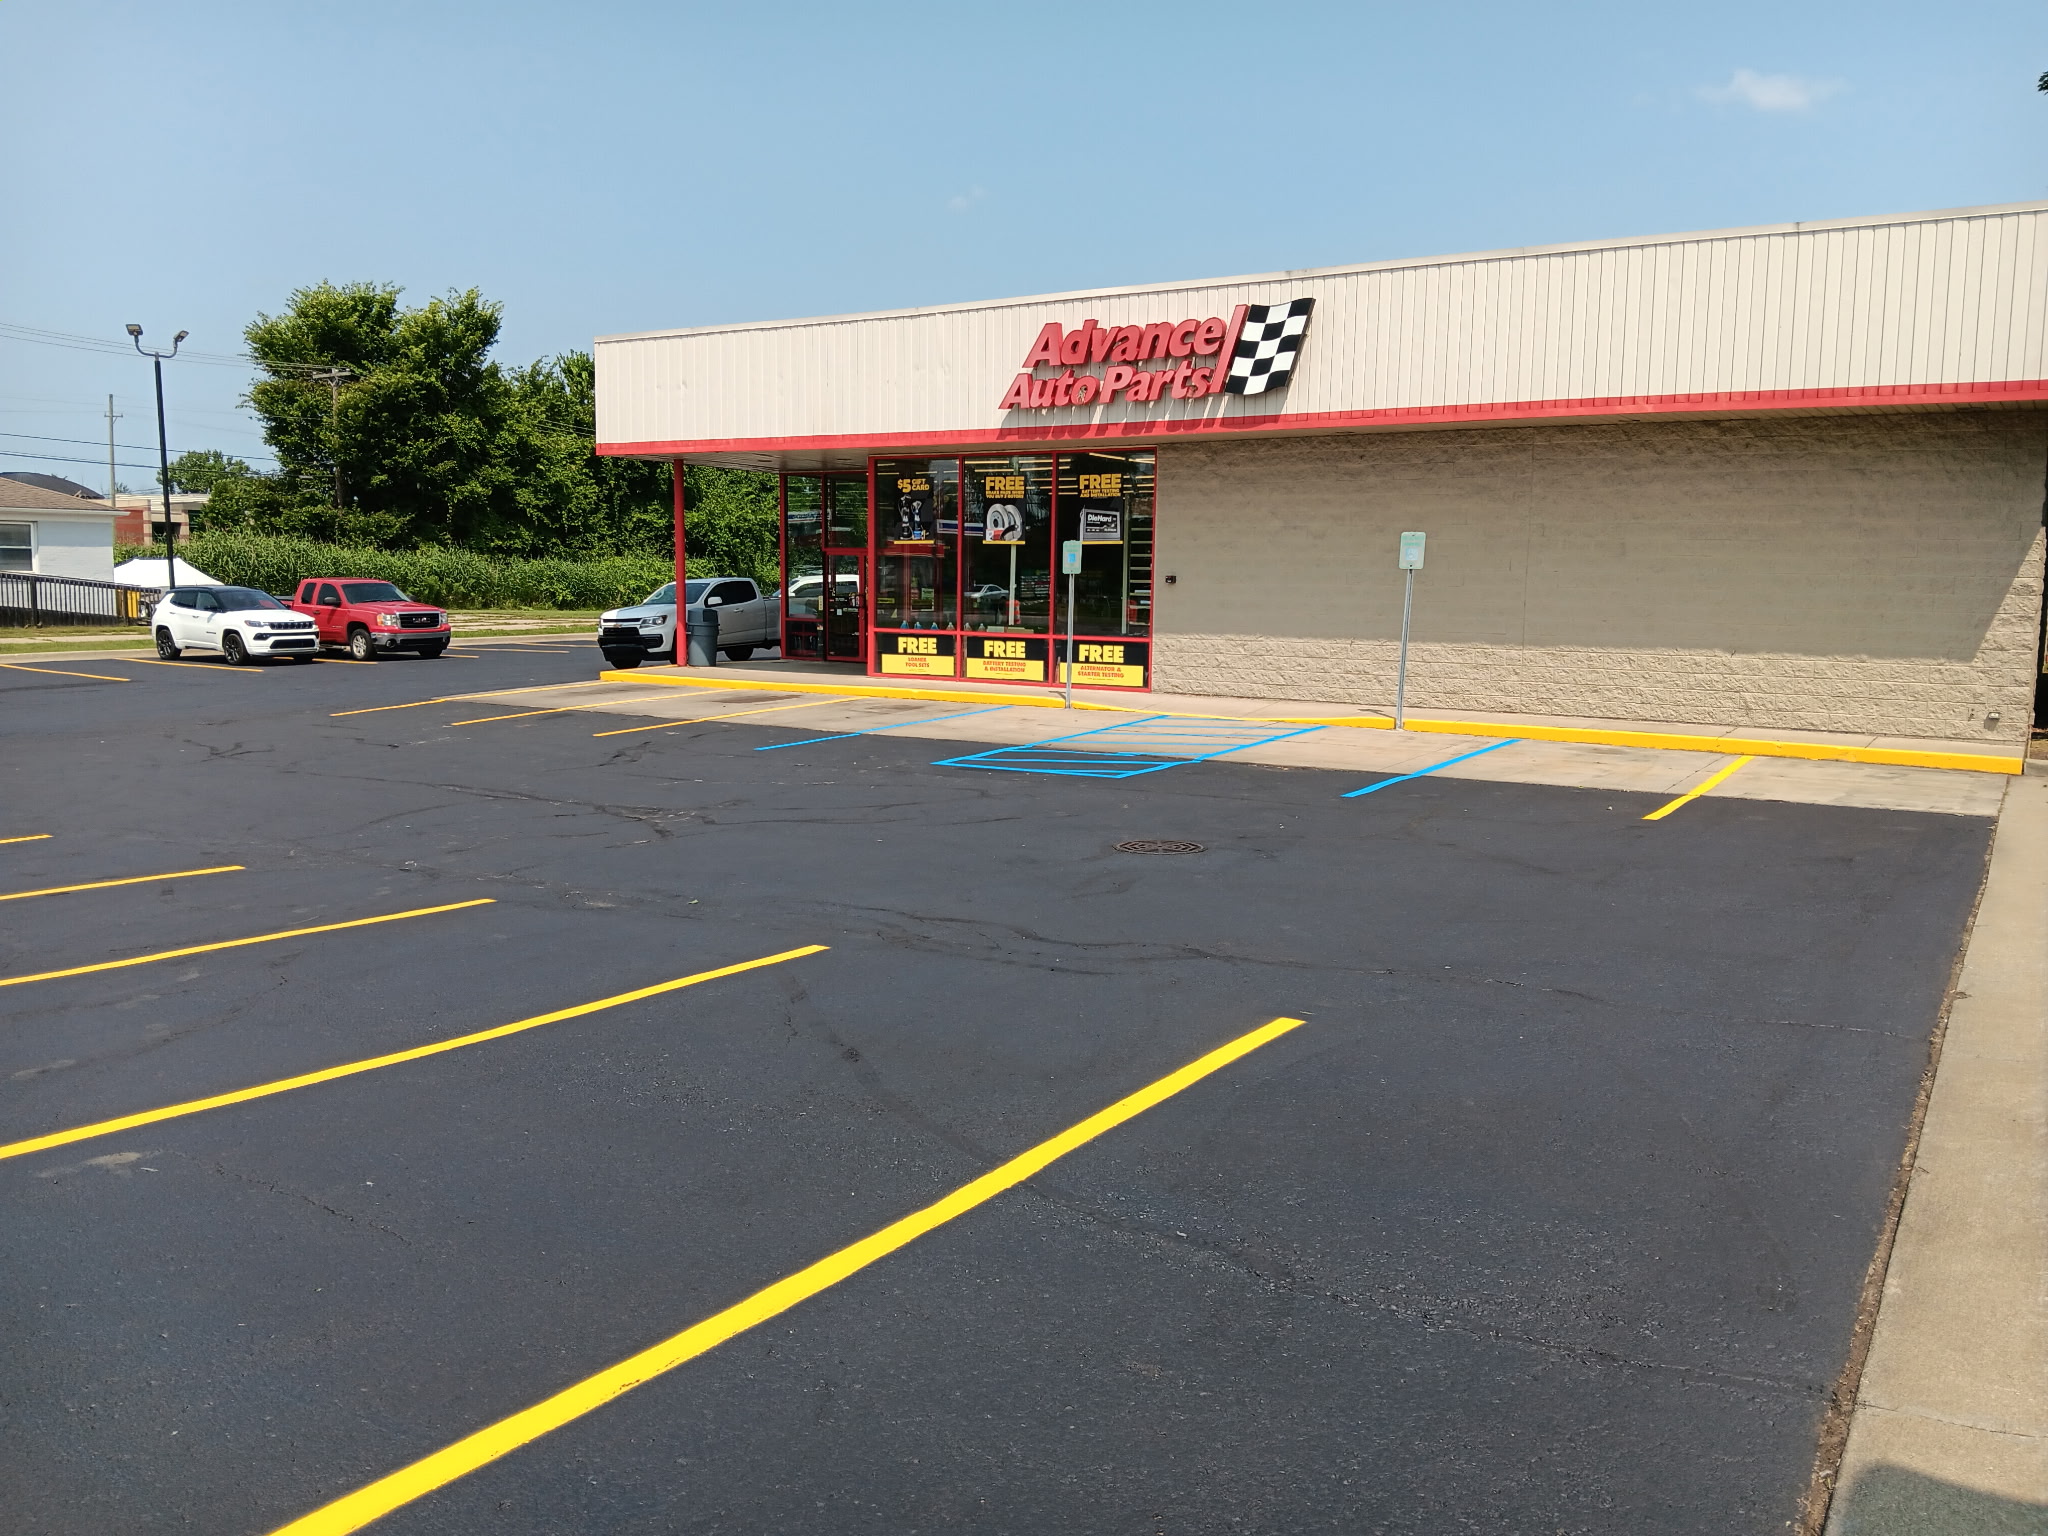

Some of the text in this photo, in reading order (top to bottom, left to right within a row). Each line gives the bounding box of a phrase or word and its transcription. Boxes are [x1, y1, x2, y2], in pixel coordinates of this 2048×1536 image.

[1022, 317, 1227, 368] Advance
[998, 359, 1215, 410] Auto Parts
[897, 479, 911, 493] $5
[986, 476, 1024, 490] FREE
[1080, 474, 1121, 489] FREE
[898, 636, 937, 654] FREE
[984, 640, 1026, 659] FREE
[1078, 644, 1125, 663] FREE
